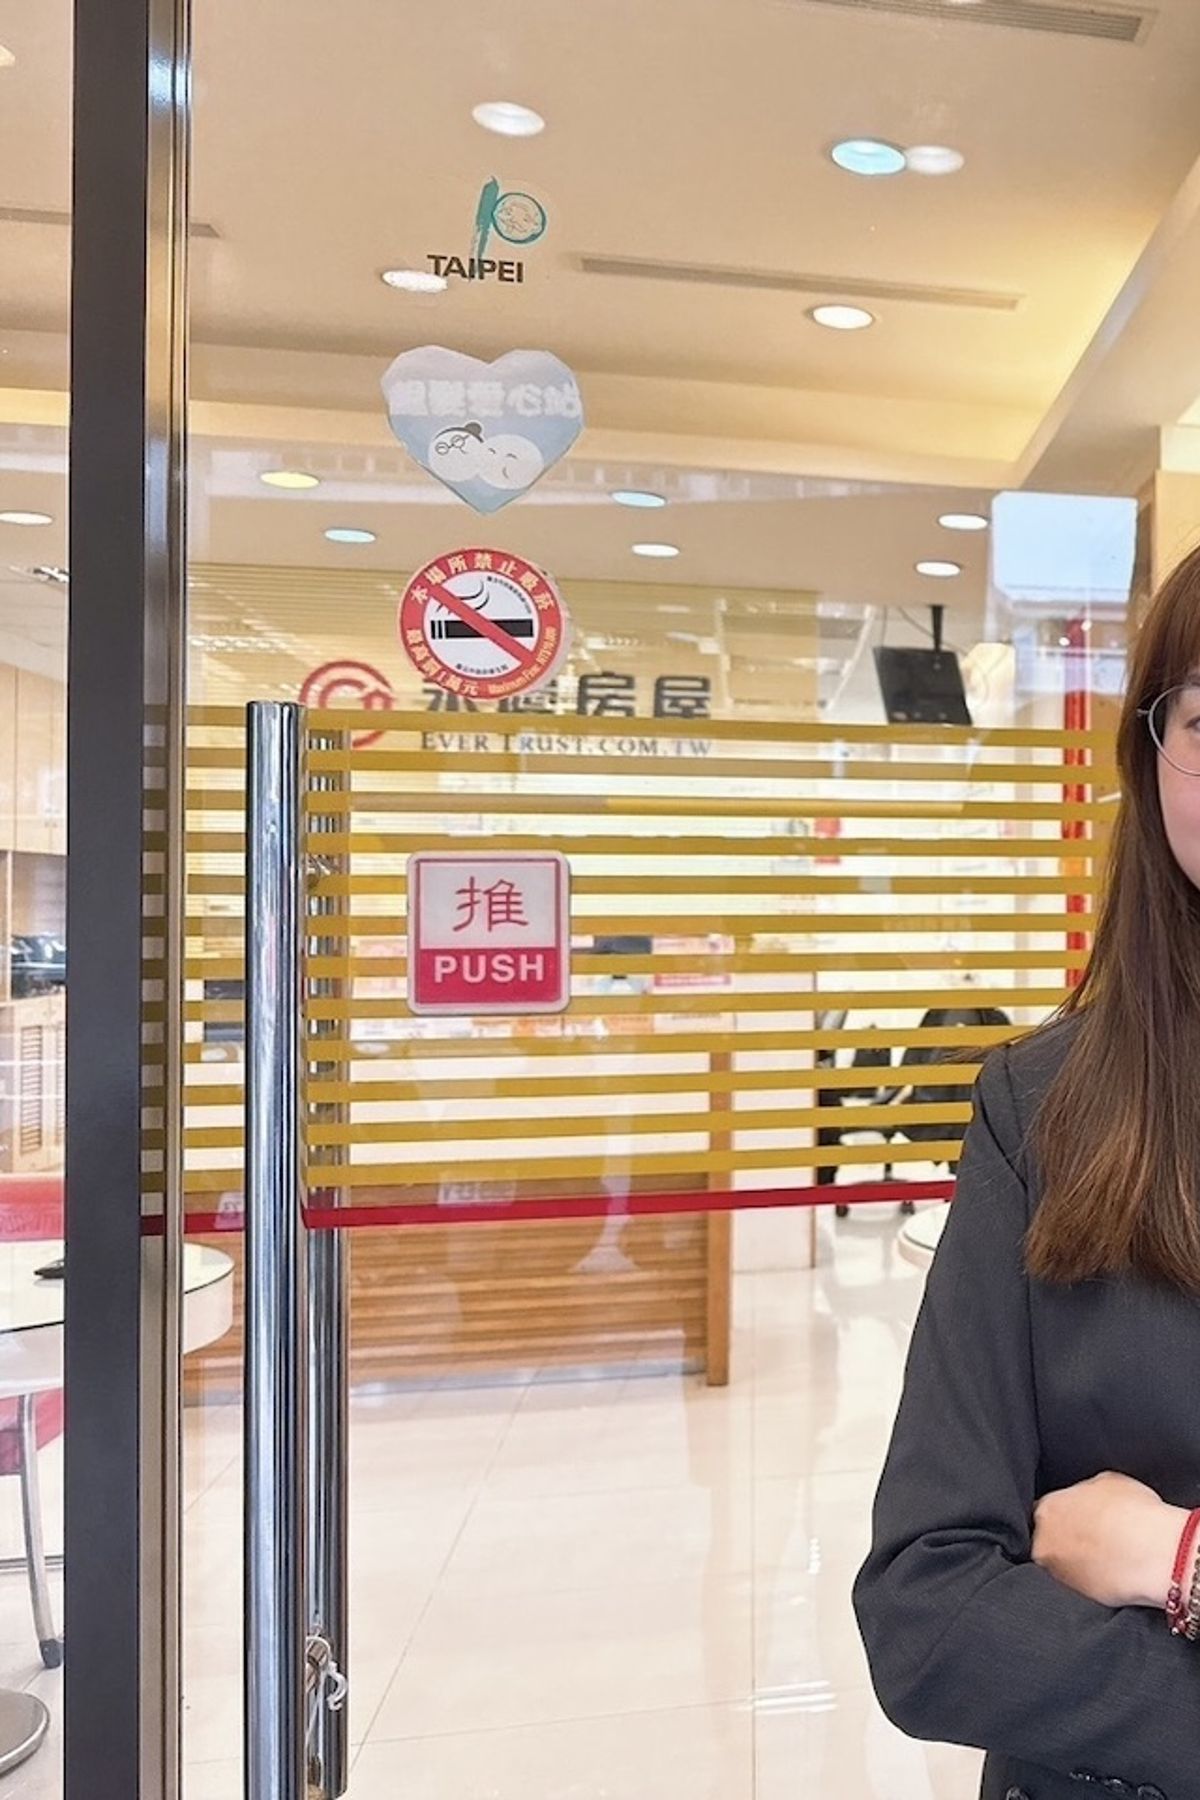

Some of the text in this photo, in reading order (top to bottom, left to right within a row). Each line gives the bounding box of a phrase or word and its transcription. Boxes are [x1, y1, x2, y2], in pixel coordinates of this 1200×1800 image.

[427, 254, 524, 283] TAIPEI
[422, 731, 490, 752] EVER
[453, 876, 529, 932] 推
[434, 954, 544, 983] PUSH
